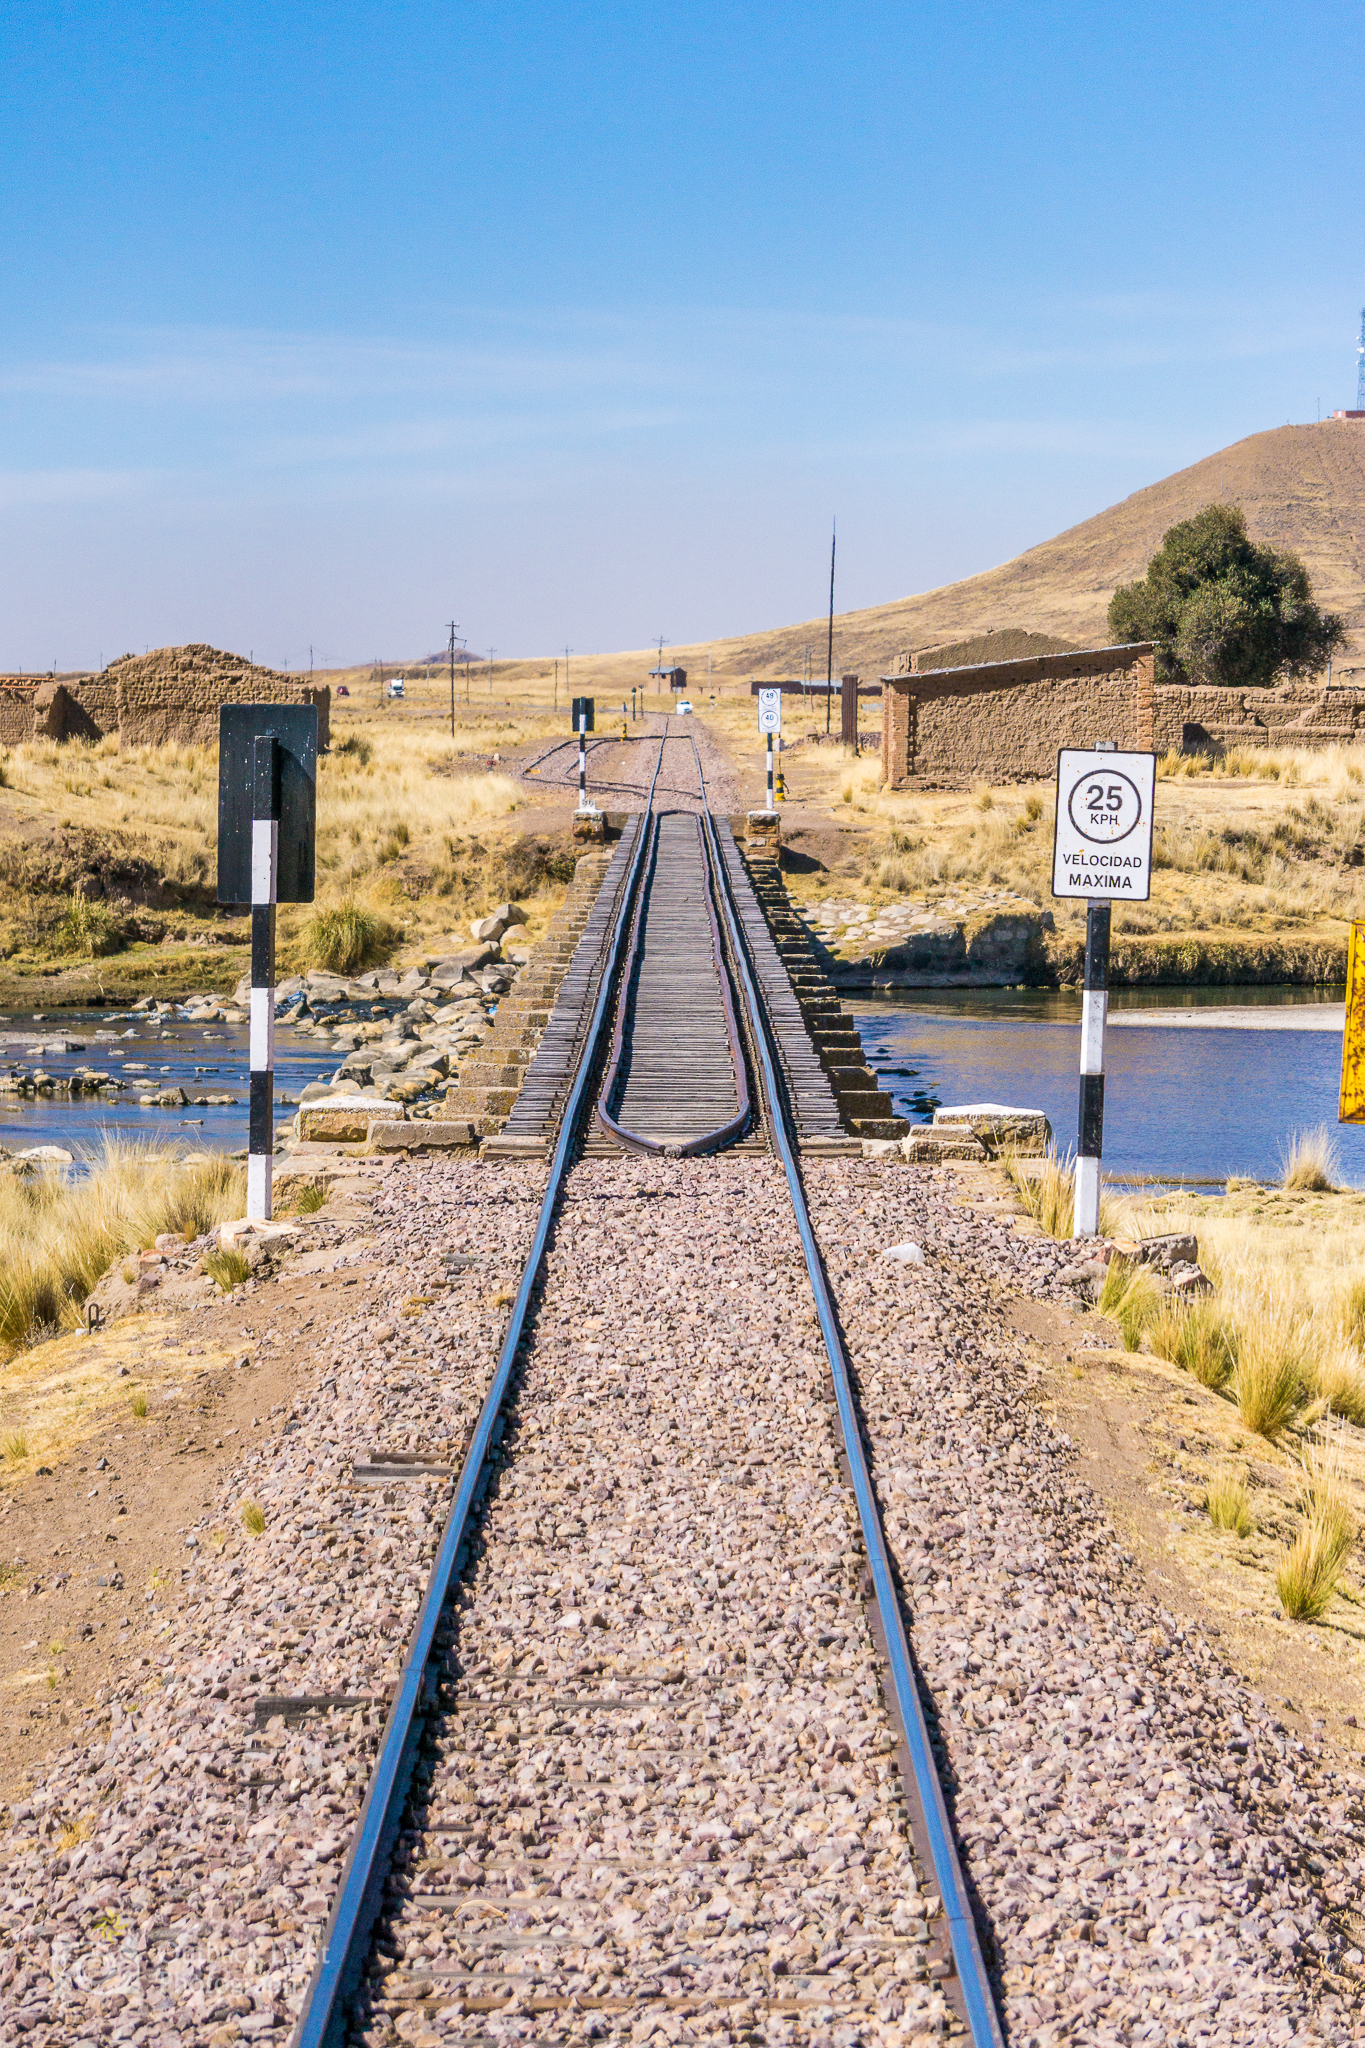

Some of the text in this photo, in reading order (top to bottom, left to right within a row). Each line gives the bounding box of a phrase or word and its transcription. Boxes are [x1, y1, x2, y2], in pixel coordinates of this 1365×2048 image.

[1086, 784, 1123, 811] 25
[1090, 813, 1119, 825] KPH
[1063, 854, 1142, 868] VELOCIDAD
[1069, 873, 1132, 888] MAXIMA
